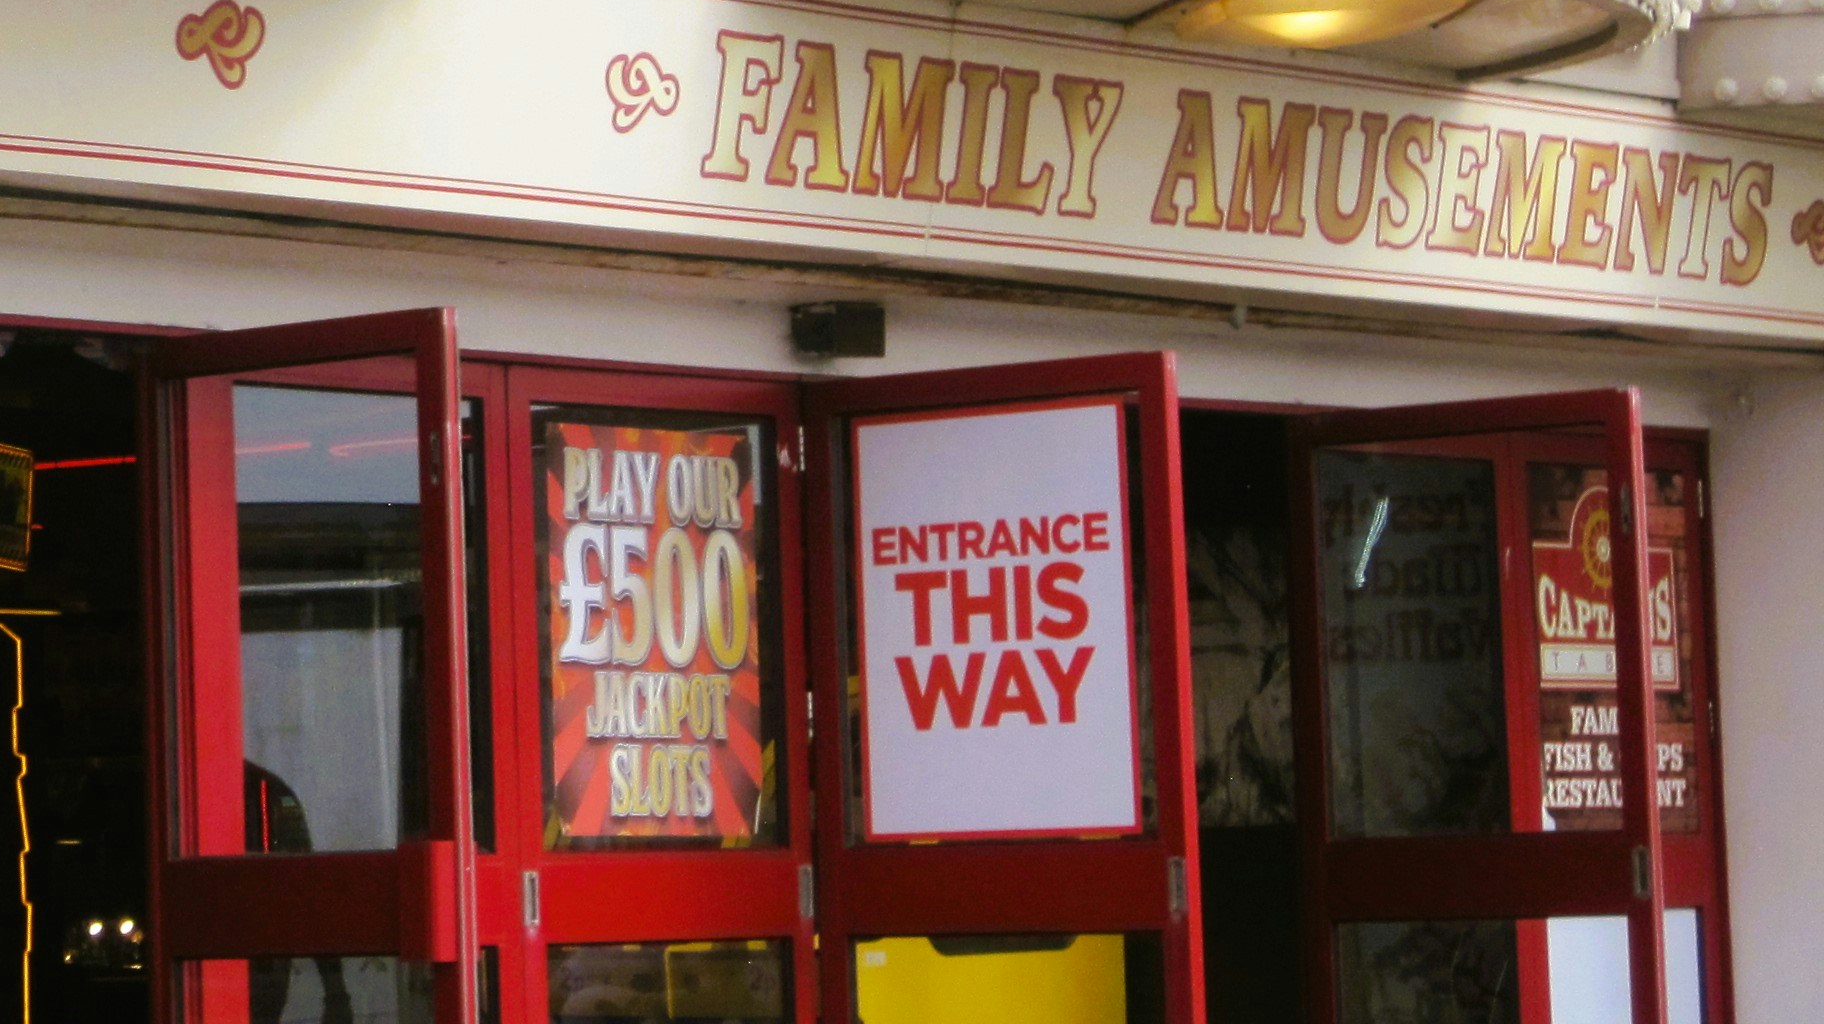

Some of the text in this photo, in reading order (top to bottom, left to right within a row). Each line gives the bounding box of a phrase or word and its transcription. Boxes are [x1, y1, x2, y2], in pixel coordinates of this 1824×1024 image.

[701, 30, 1773, 286] FAMILY AMUSEMENTS
[563, 446, 742, 528] PLAY OUR
[872, 512, 1110, 566] ENTRANCE
[559, 522, 749, 669] £500
[895, 561, 1089, 647] THIS
[894, 646, 1096, 731] WAY
[1552, 652, 1664, 674] TABE
[586, 671, 731, 739] JACKPOT
[610, 744, 713, 817] SLOTS
[1543, 742, 1614, 771] FISH &
